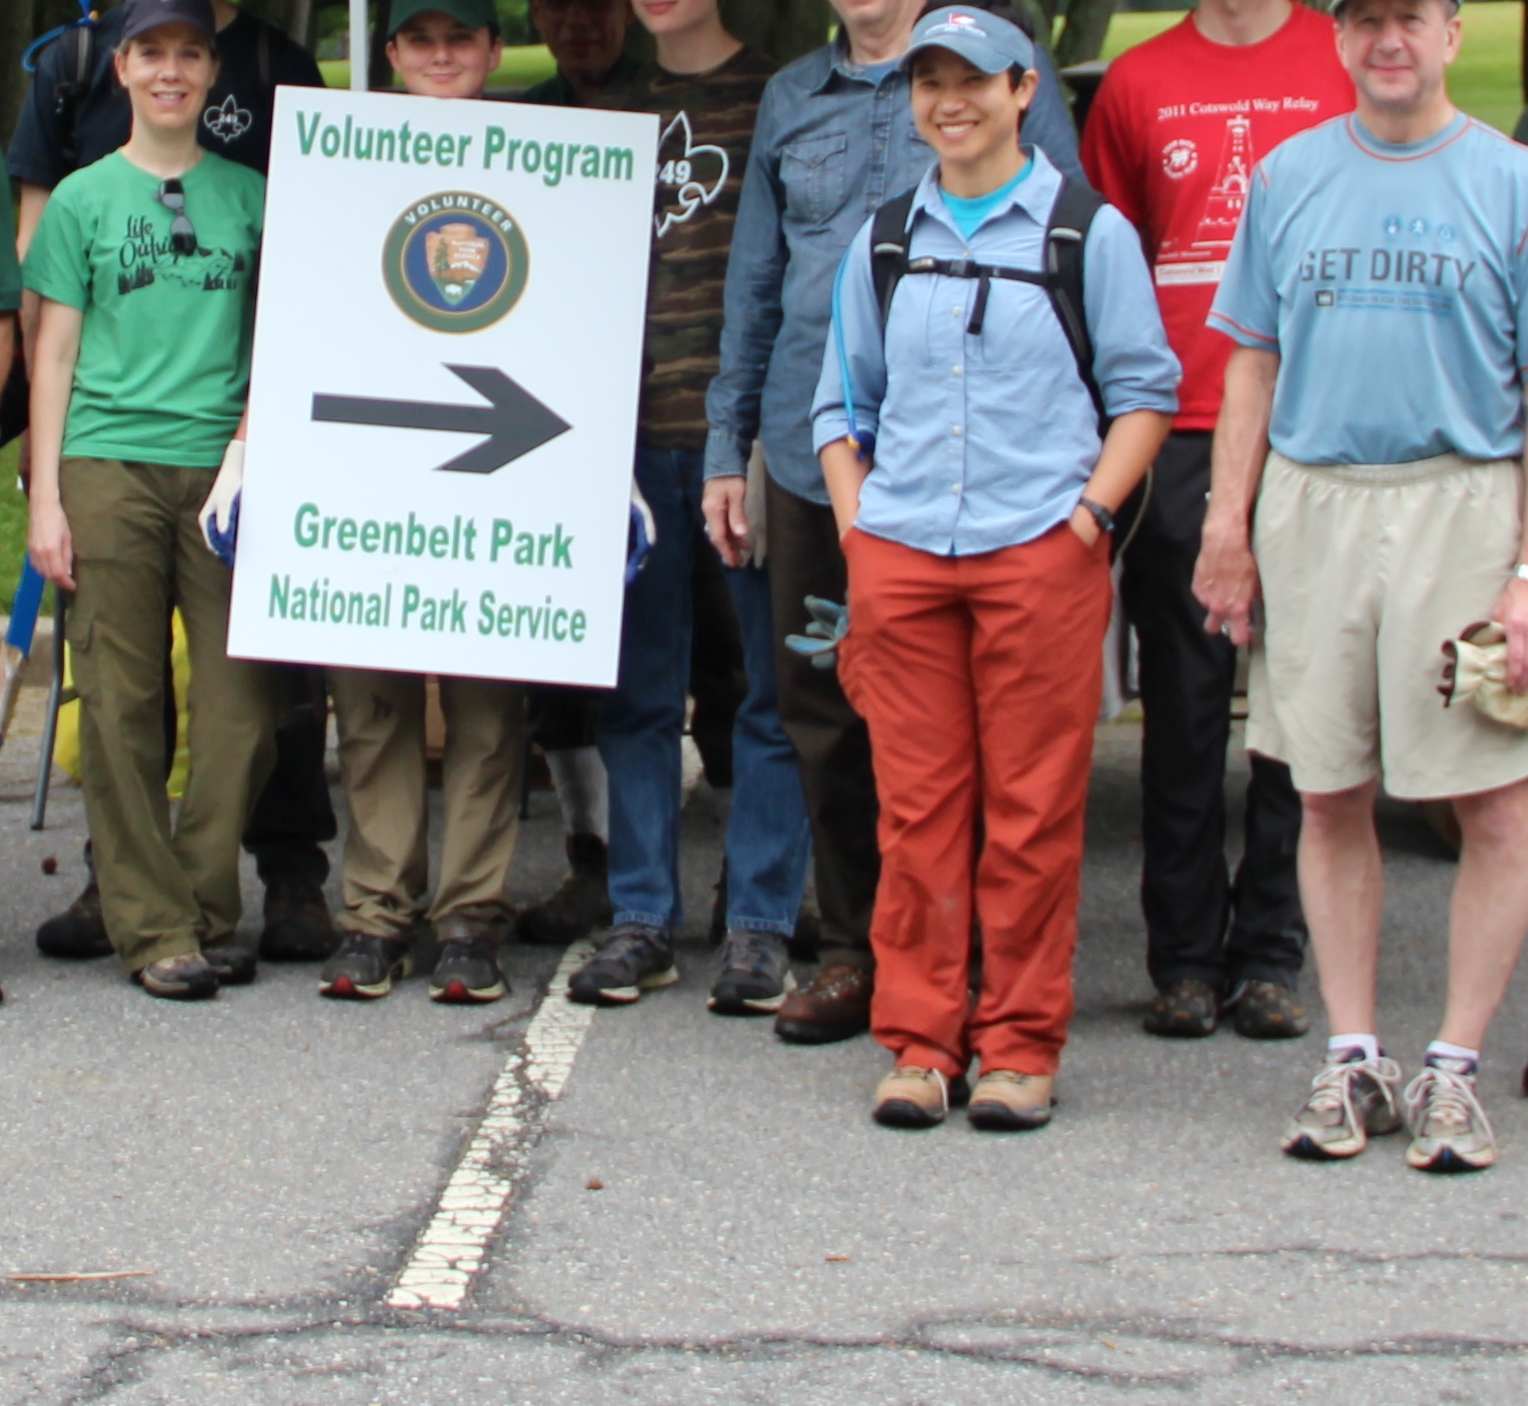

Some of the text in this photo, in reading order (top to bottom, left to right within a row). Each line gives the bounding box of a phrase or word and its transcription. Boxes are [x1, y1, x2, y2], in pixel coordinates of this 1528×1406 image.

[1158, 96, 1319, 120] 2011 Cotswold Way Relay
[295, 111, 635, 187] Volunteer Program
[655, 159, 692, 185] 49
[404, 195, 514, 234] VOLUNTEER
[1299, 248, 1476, 292] GET DIRTY
[293, 503, 574, 569] Greenbelt Park
[267, 574, 587, 644] National Park Service
